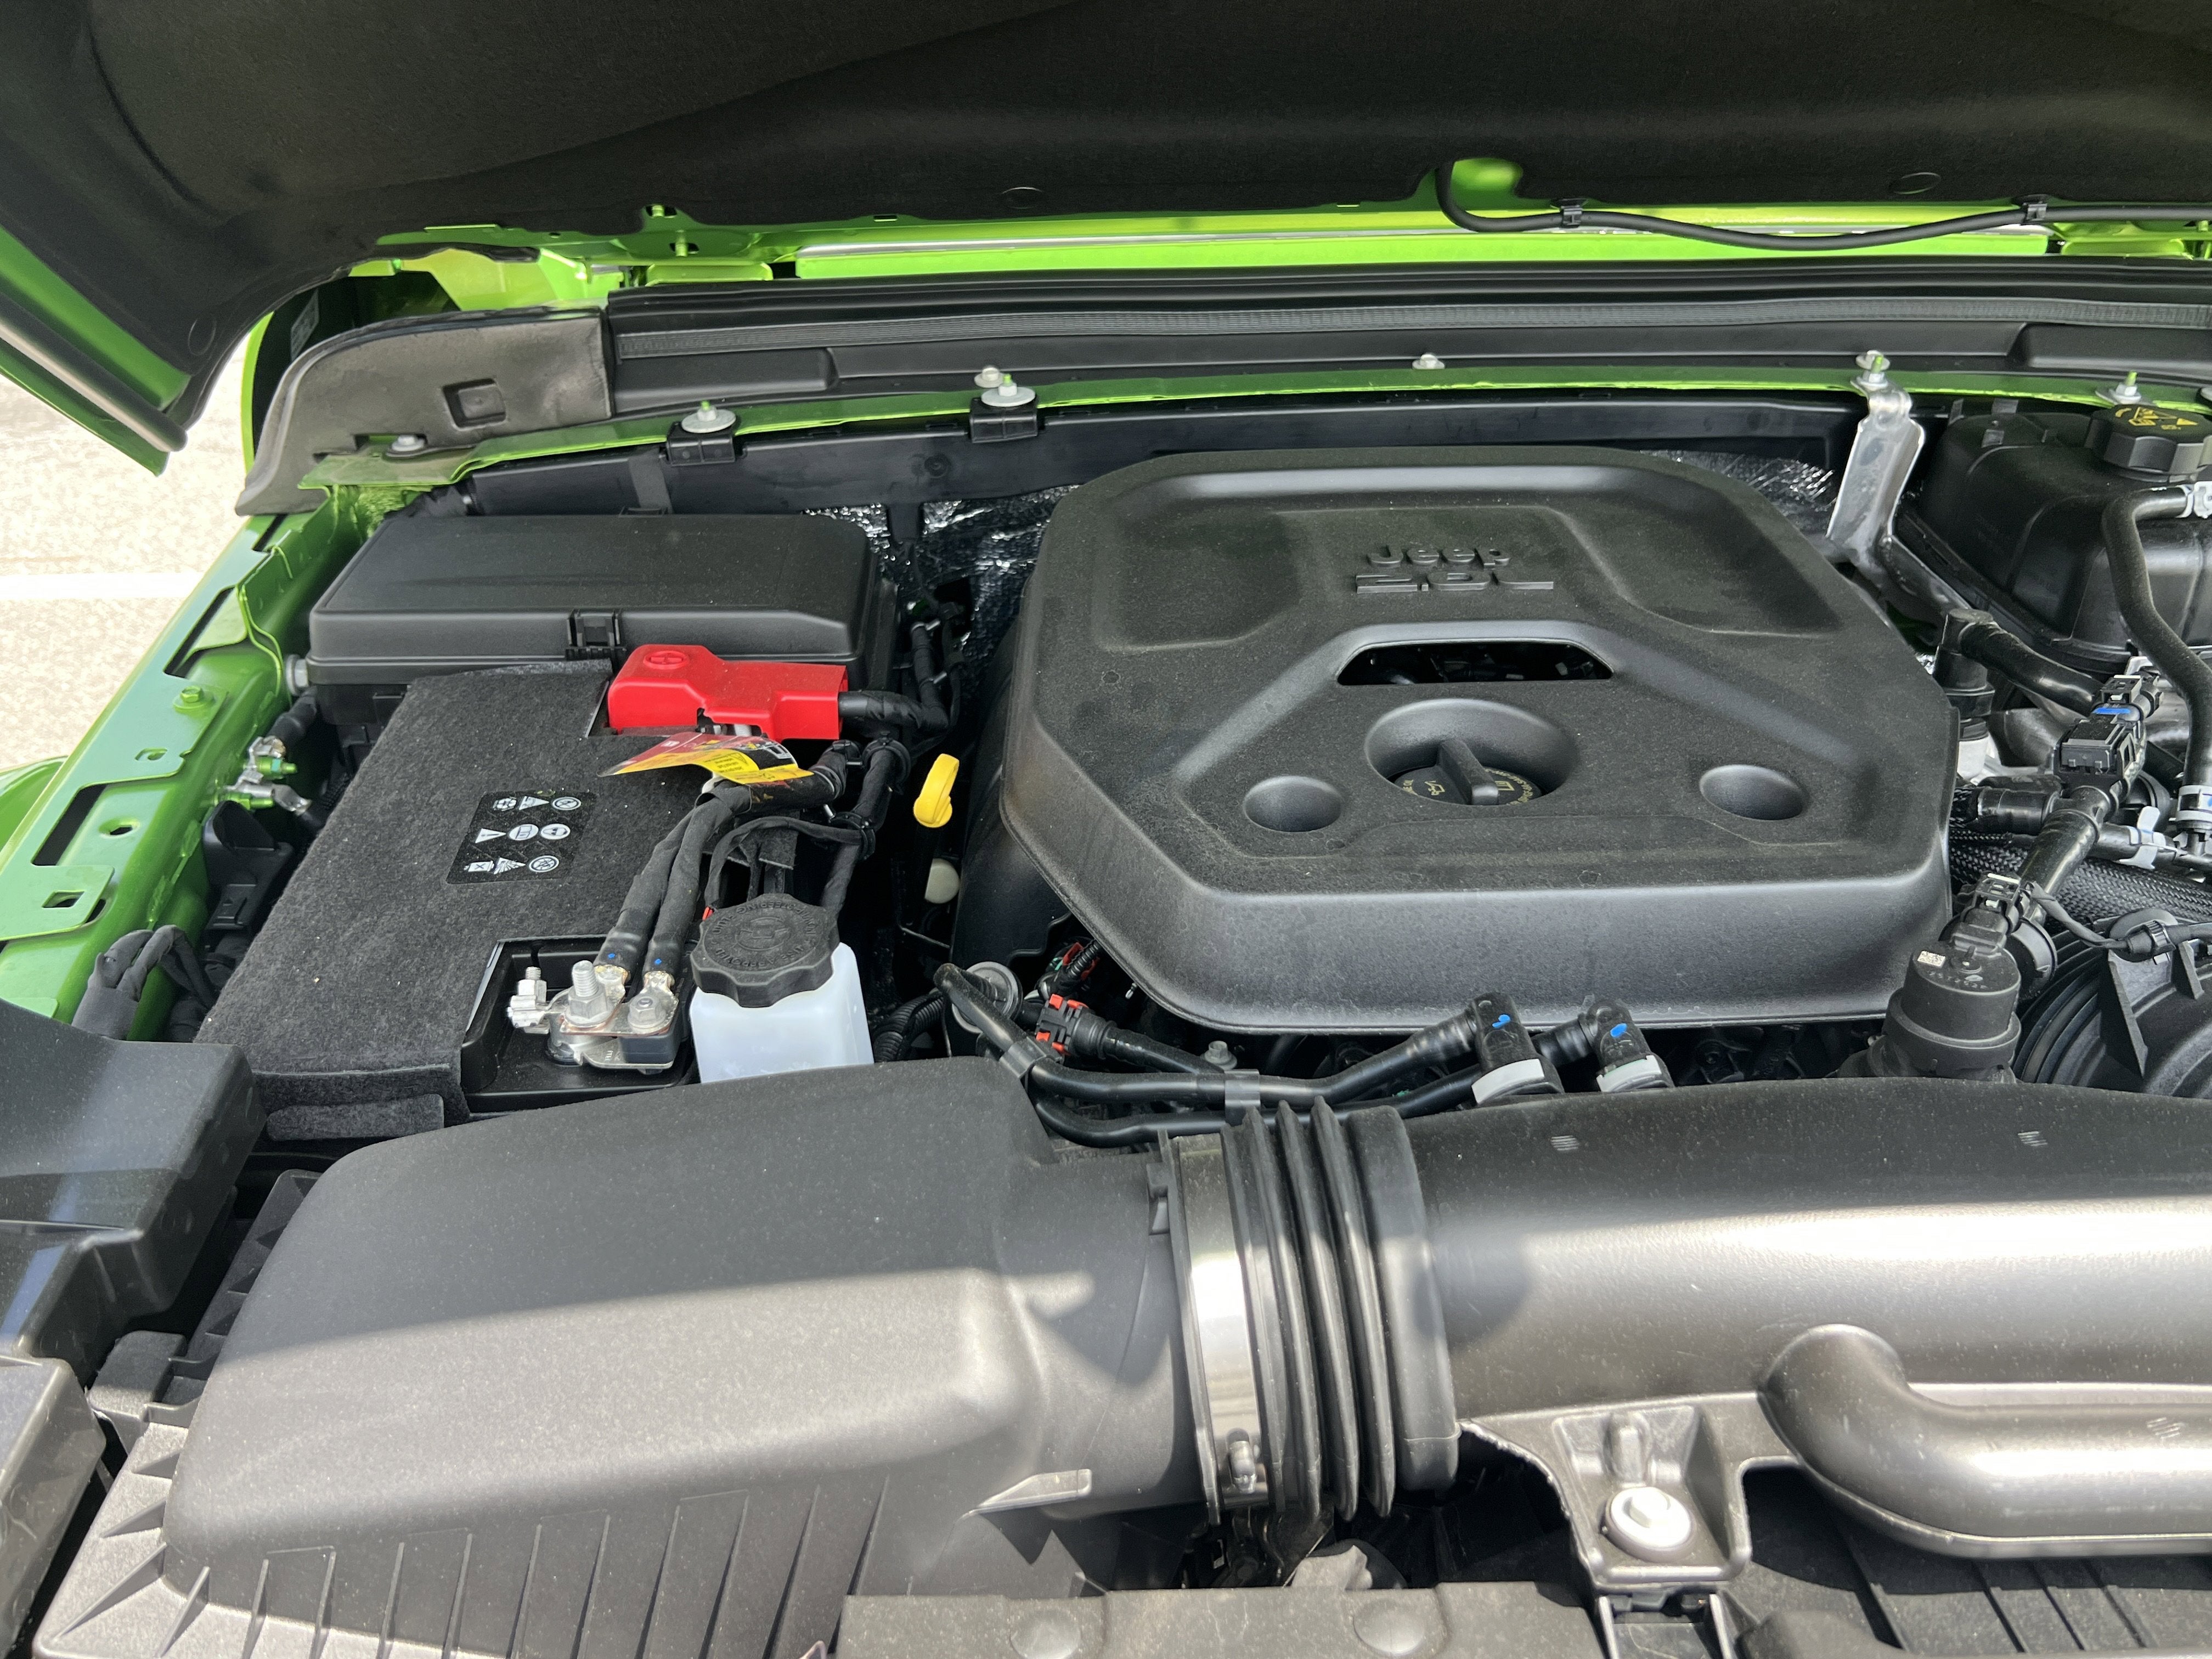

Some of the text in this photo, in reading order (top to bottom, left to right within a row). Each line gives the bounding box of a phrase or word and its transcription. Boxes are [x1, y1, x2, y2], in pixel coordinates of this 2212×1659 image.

[1367, 545, 1510, 569] Jeep
[736, 900, 796, 913] STEERING
[713, 915, 737, 933] FLUID
[715, 945, 804, 969] USE APPROVED
